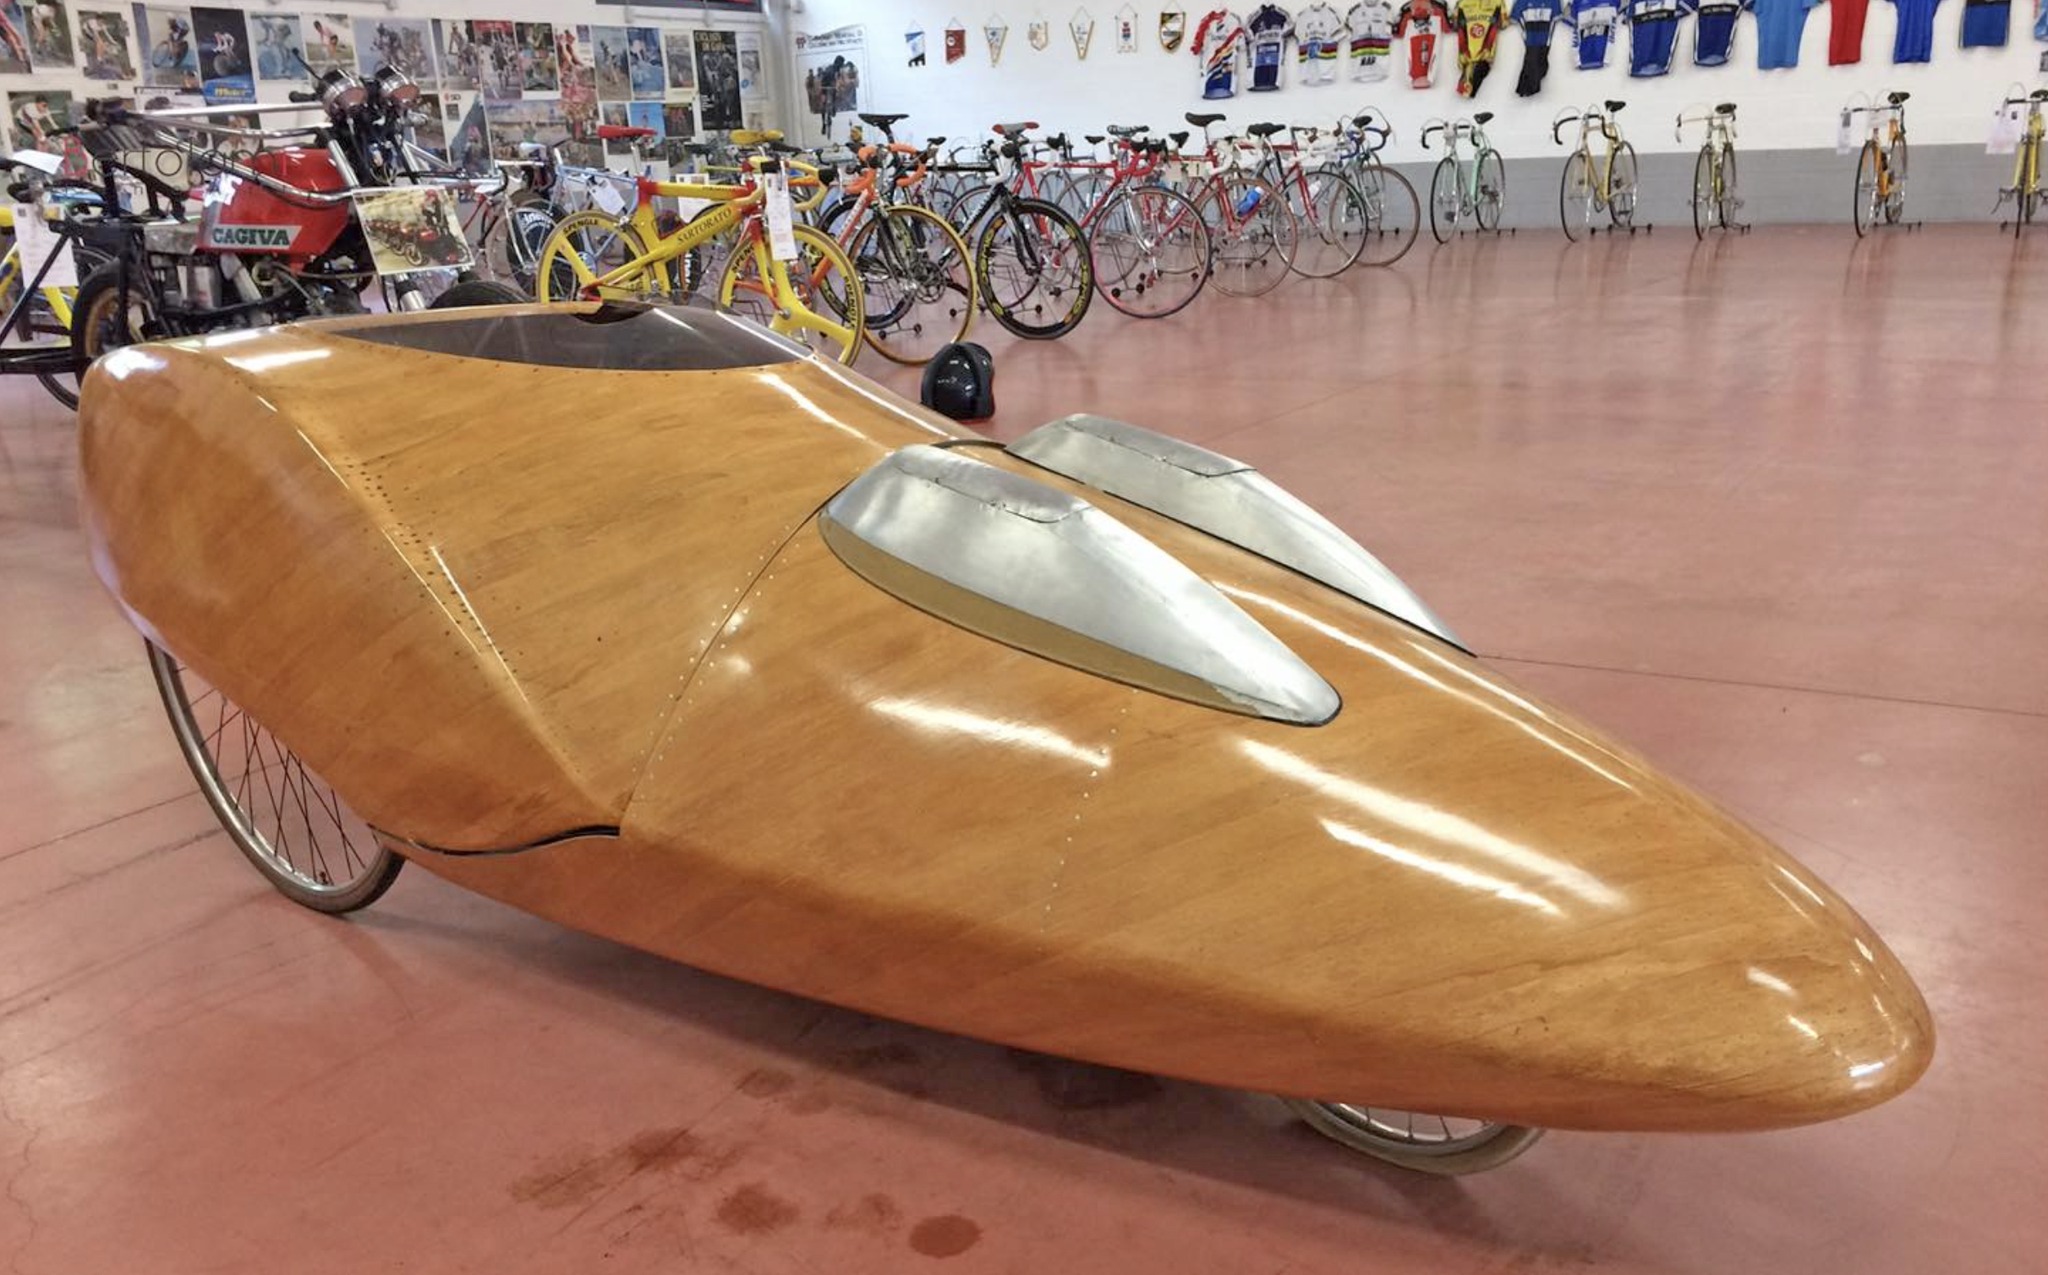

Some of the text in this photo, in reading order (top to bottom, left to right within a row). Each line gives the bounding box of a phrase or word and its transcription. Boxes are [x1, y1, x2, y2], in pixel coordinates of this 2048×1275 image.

[563, 218, 598, 234] SPENGLE
[677, 208, 732, 245] SARTORATO
[212, 228, 290, 246] CAGIVA
